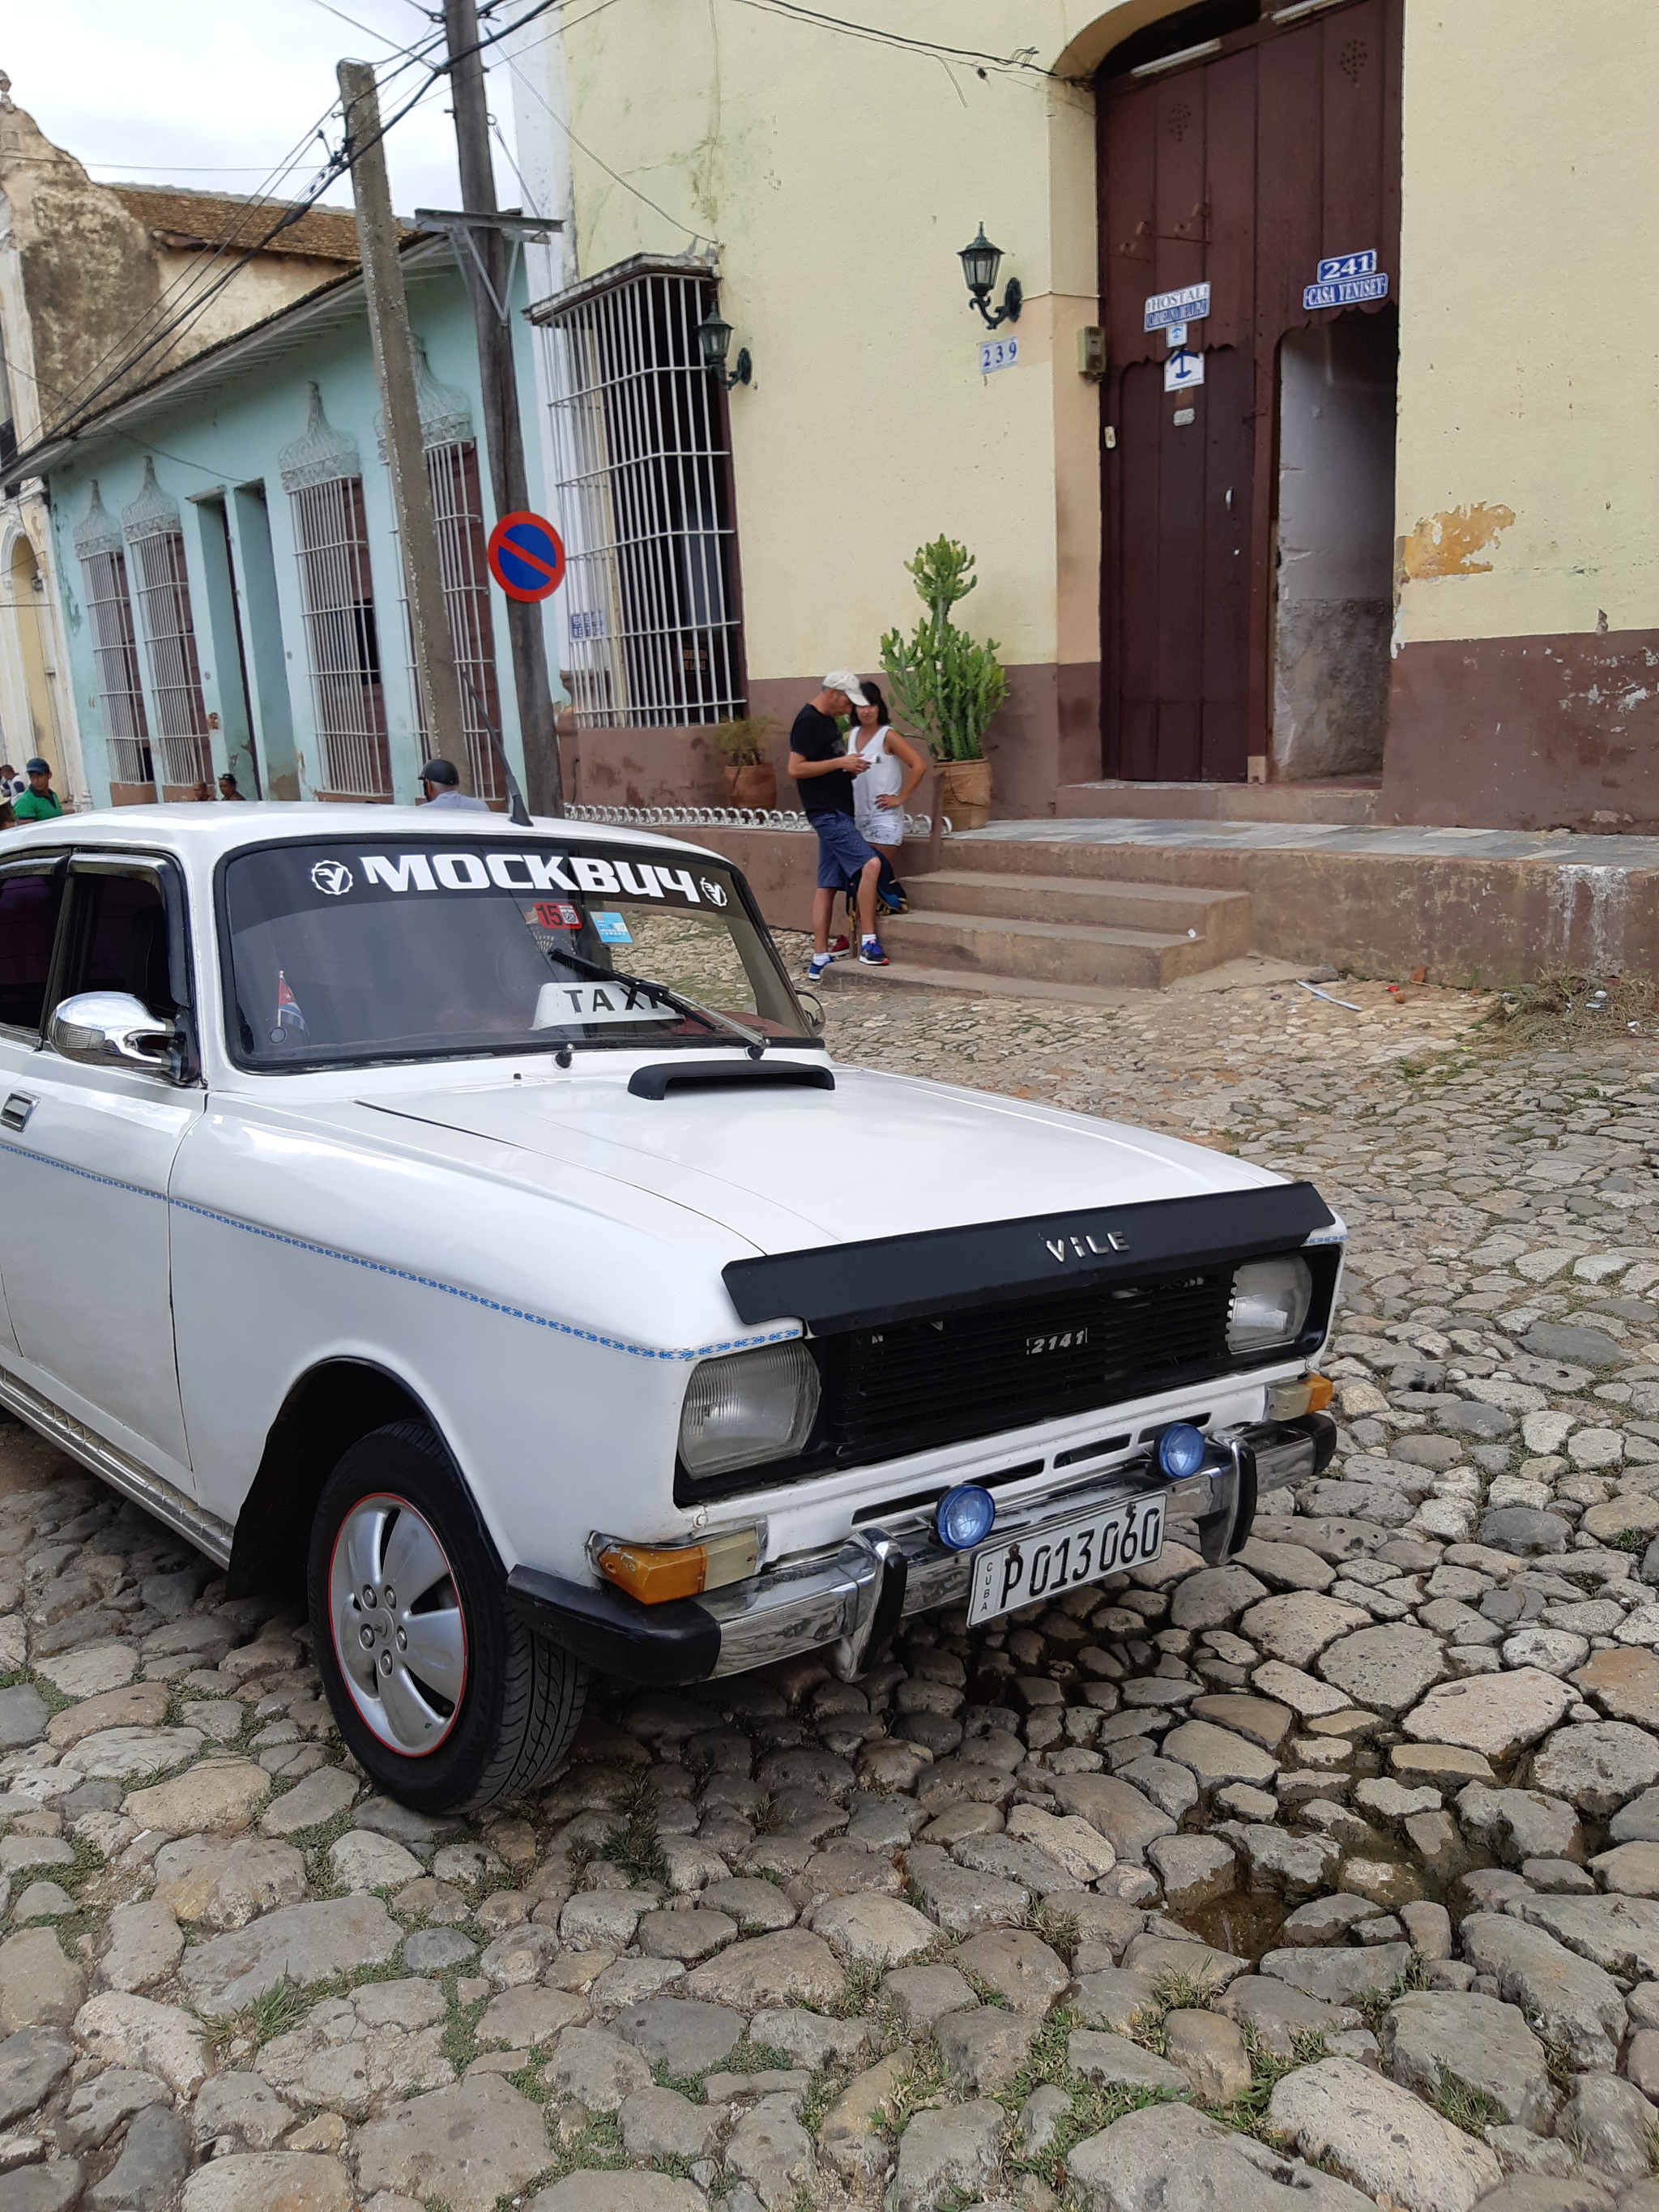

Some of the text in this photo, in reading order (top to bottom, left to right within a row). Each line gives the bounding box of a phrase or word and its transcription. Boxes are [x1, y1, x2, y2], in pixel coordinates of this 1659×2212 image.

[1322, 254, 1371, 280] 241
[1150, 287, 1204, 311] HOSTAL
[1308, 277, 1384, 305] CASA YENISEY
[983, 341, 1017, 367] 239
[359, 853, 702, 903] МОСКВИЧ
[536, 903, 564, 926] 15
[1031, 1330, 1085, 1354] 2141
[980, 1561, 993, 1612] CUBA
